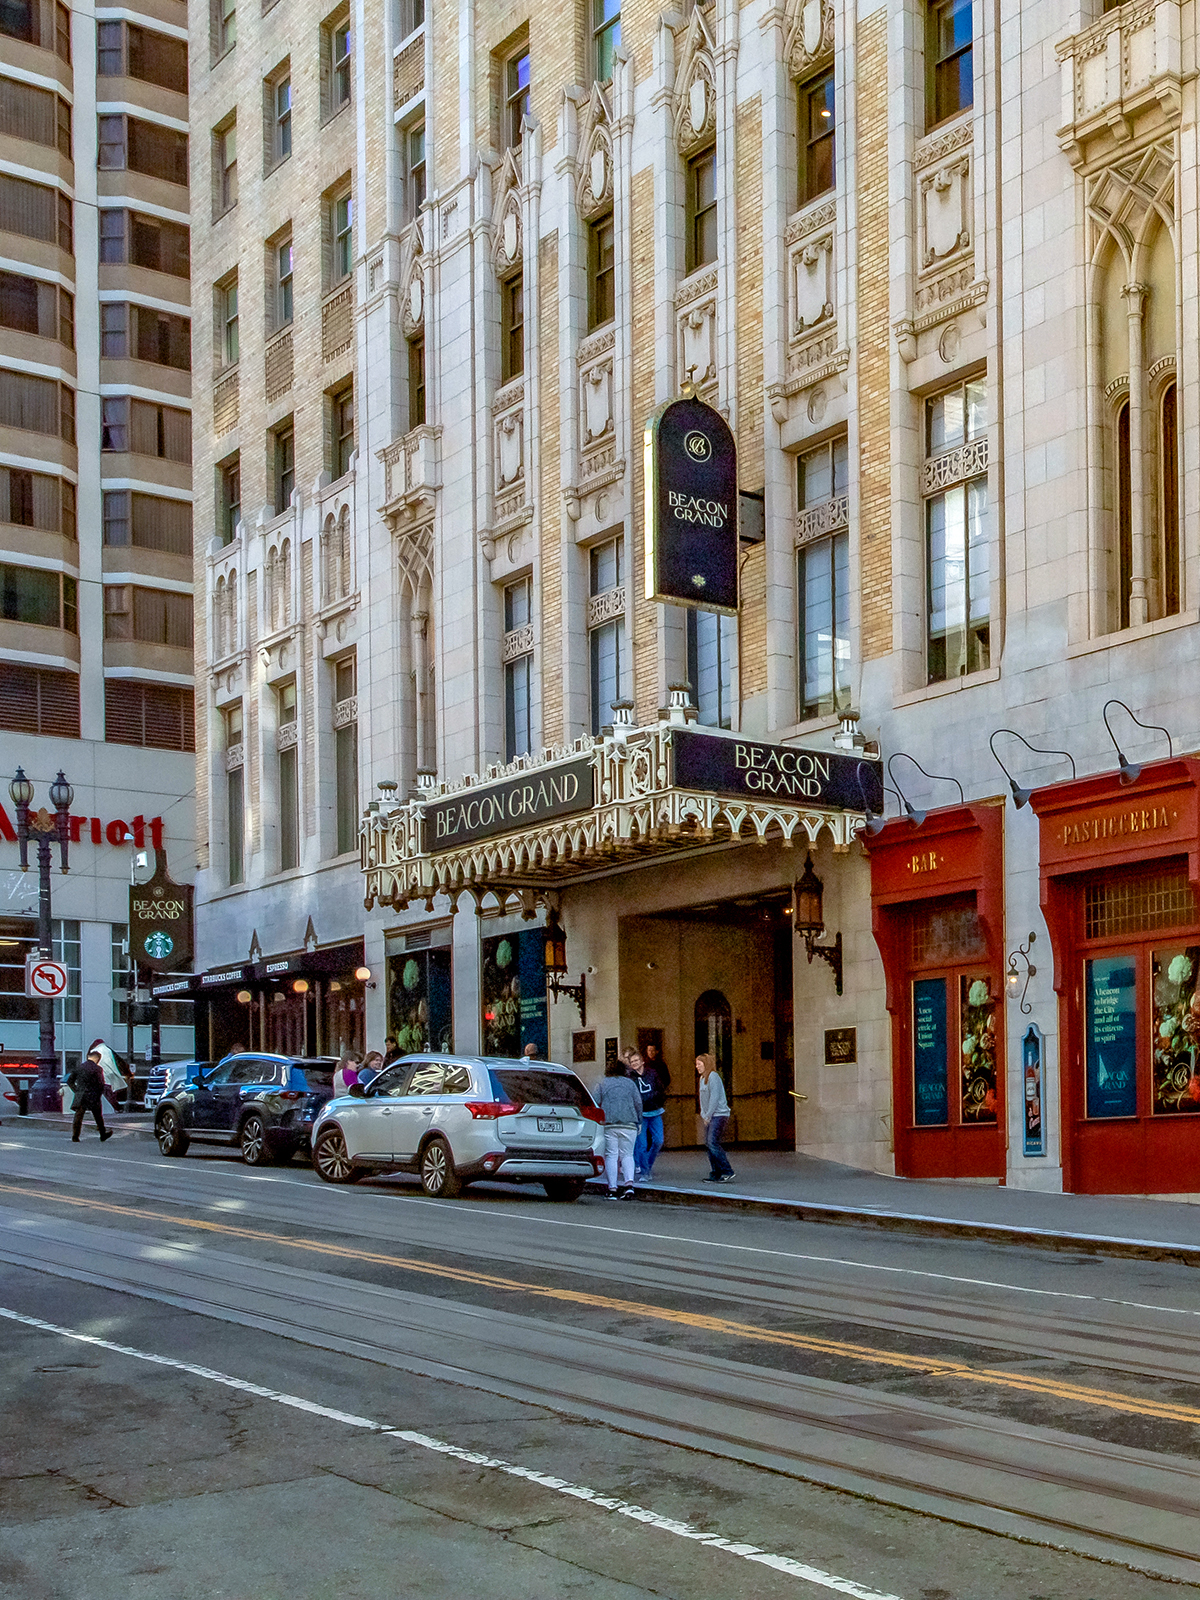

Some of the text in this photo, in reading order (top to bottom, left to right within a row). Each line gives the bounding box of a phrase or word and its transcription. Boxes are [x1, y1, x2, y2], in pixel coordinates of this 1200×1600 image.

[669, 490, 728, 520] BEACON
[674, 506, 724, 528] GRAND
[735, 744, 830, 781] BEACON
[745, 770, 822, 797] GRAND
[436, 773, 579, 838] BEACON GRAND
[1064, 807, 1168, 846] PASTICCERIA
[912, 851, 938, 873] BAR
[133, 900, 184, 912] BEACON
[138, 910, 180, 920] GRAND
[226, 971, 242, 981] COFFEE
[266, 961, 289, 973] ESPRESSO
